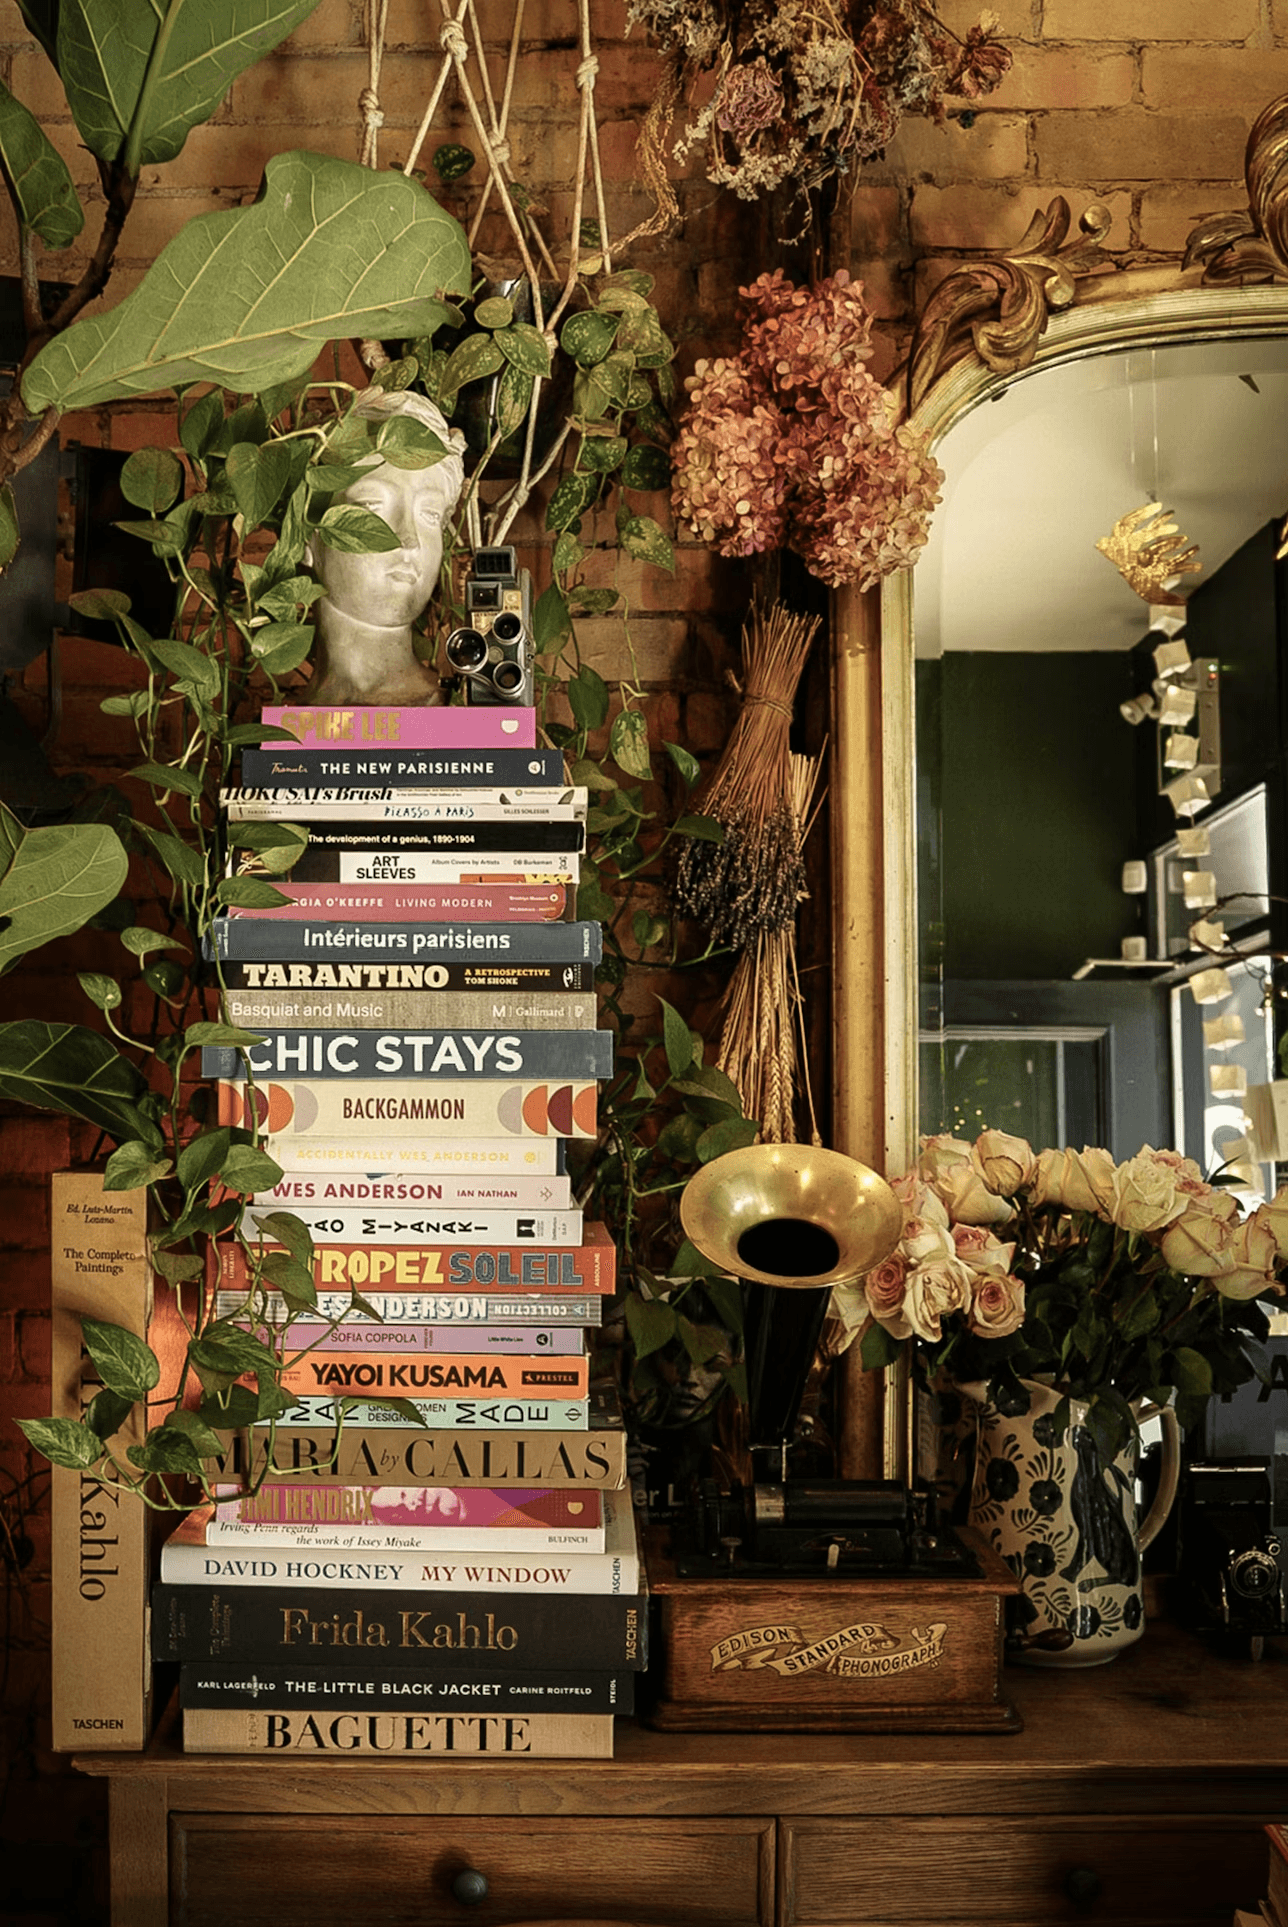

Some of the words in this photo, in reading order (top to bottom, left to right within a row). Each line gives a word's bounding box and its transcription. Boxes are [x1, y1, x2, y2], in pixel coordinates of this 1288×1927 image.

[281, 711, 355, 742] SPIKE
[361, 711, 401, 742] LEE
[320, 762, 350, 775] THE
[357, 762, 393, 775] NEW
[398, 762, 494, 775] PARISIENNE
[336, 787, 393, 801] Brush
[308, 834, 324, 843] The
[325, 834, 380, 845] development
[382, 834, 391, 843] of
[432, 834, 476, 843] 1890-1904
[371, 855, 401, 867] ART
[472, 859, 480, 868] by
[356, 867, 416, 880] SLEEVES
[326, 896, 384, 908] O'KEEFFE
[395, 897, 437, 908] LIVING
[441, 897, 493, 909] MODERN
[304, 927, 408, 948] Intérieurs
[412, 927, 511, 954] parisiens
[242, 963, 449, 988] TARANTINO
[464, 968, 472, 977] A
[474, 968, 551, 977] RETROSPECTIVE
[464, 976, 486, 986] TOM
[486, 976, 519, 986] SHONE
[232, 1001, 300, 1021] Basquiat
[303, 1002, 333, 1018] and
[336, 1002, 383, 1018] Music
[515, 1005, 566, 1018] Gallimard
[242, 1035, 359, 1072] CHIC
[375, 1035, 524, 1073] STAYS
[343, 1098, 465, 1120] BACKGAMMON
[296, 1149, 394, 1162] ACCIDENTALLY
[398, 1150, 429, 1162] WES
[433, 1150, 511, 1163] ANDERSON
[272, 1182, 316, 1199] WES
[324, 1183, 443, 1200] ANDERSON
[457, 1189, 475, 1199] IAN
[477, 1189, 518, 1199] NATHAN
[84, 1215, 115, 1224] Lozano
[361, 1218, 489, 1234] MIYAZAKI
[63, 1248, 84, 1260] The
[87, 1248, 136, 1263] Complete
[75, 1261, 124, 1276] Paintings
[449, 1250, 583, 1286] SOLEIL
[346, 1296, 488, 1320] NDERSON
[494, 1304, 568, 1317] COLLECTION
[330, 1332, 363, 1343] SOFIA
[366, 1332, 418, 1344] COPPOLA
[310, 1363, 388, 1387] YAYOI
[390, 1364, 507, 1389] KUSAMA
[535, 1373, 574, 1383] PRESTEL
[415, 1403, 447, 1413] OMEN
[455, 1402, 549, 1423] MADE
[206, 1436, 379, 1479] MARIA
[380, 1445, 399, 1473] by
[405, 1438, 610, 1480] CALLAS
[237, 1488, 280, 1521] JIMI
[285, 1488, 374, 1522] HENDRIX
[220, 1522, 251, 1534] Irving
[253, 1523, 279, 1532] Penn
[281, 1523, 319, 1536] regards
[80, 1473, 120, 1602] Kahlo
[296, 1535, 312, 1545] the
[314, 1535, 340, 1545] work
[342, 1535, 355, 1547] of
[357, 1536, 381, 1548] Issey
[384, 1536, 422, 1550] Miyake
[547, 1534, 589, 1544] BULFINCH
[203, 1559, 278, 1579] DAVID
[286, 1561, 404, 1581] HOCKNEY
[420, 1565, 457, 1582] MY
[464, 1566, 571, 1584] WINDOW
[611, 1556, 621, 1595] TASCHEN
[279, 1607, 391, 1648] Frida
[397, 1609, 519, 1651] Kahlo
[625, 1608, 638, 1661] TASCHEN
[717, 1627, 792, 1659] EDISON
[783, 1624, 876, 1671] STANDARD
[841, 1645, 936, 1675] PHONOGRAPH
[196, 1681, 221, 1690] KARL
[223, 1681, 277, 1691] LAGERFELD
[285, 1681, 317, 1694] THE
[323, 1682, 376, 1695] LITTLE
[381, 1682, 432, 1695] BLACK
[438, 1682, 501, 1696] JACKET
[509, 1686, 544, 1695] CARINE
[546, 1687, 592, 1696] ROITFELD
[72, 1719, 124, 1731] TASCHEN
[264, 1714, 532, 1752] BAGUETTE
